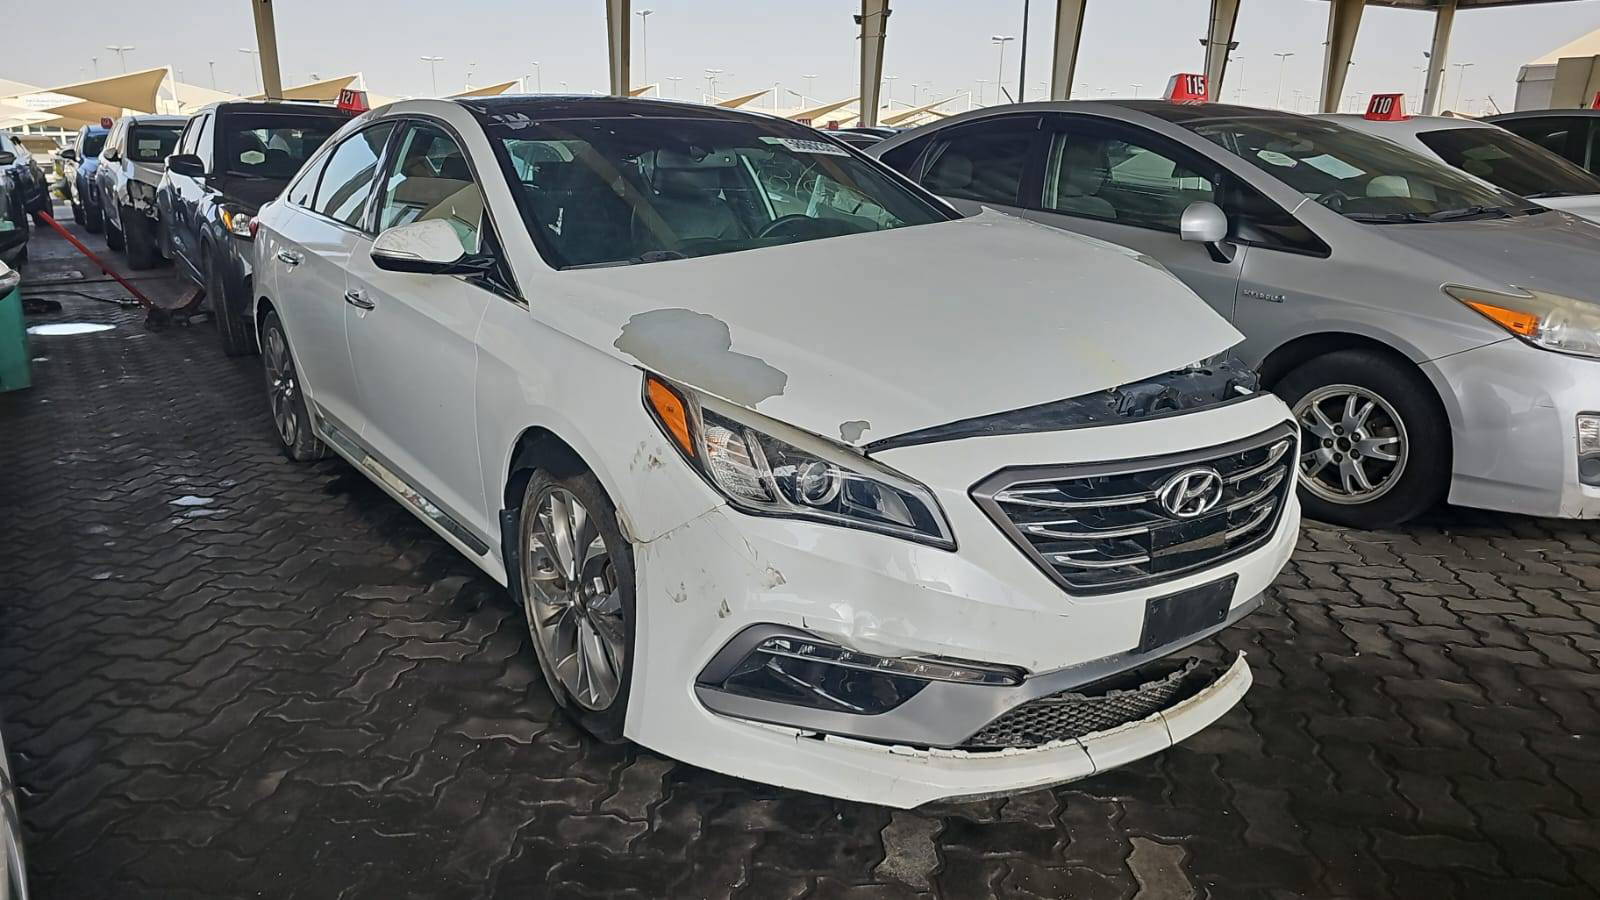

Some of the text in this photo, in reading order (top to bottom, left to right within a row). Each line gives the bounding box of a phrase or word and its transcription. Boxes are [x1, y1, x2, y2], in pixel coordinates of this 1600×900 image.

[1186, 75, 1205, 96] 115
[341, 90, 354, 104] 121
[1372, 96, 1392, 114] 110
